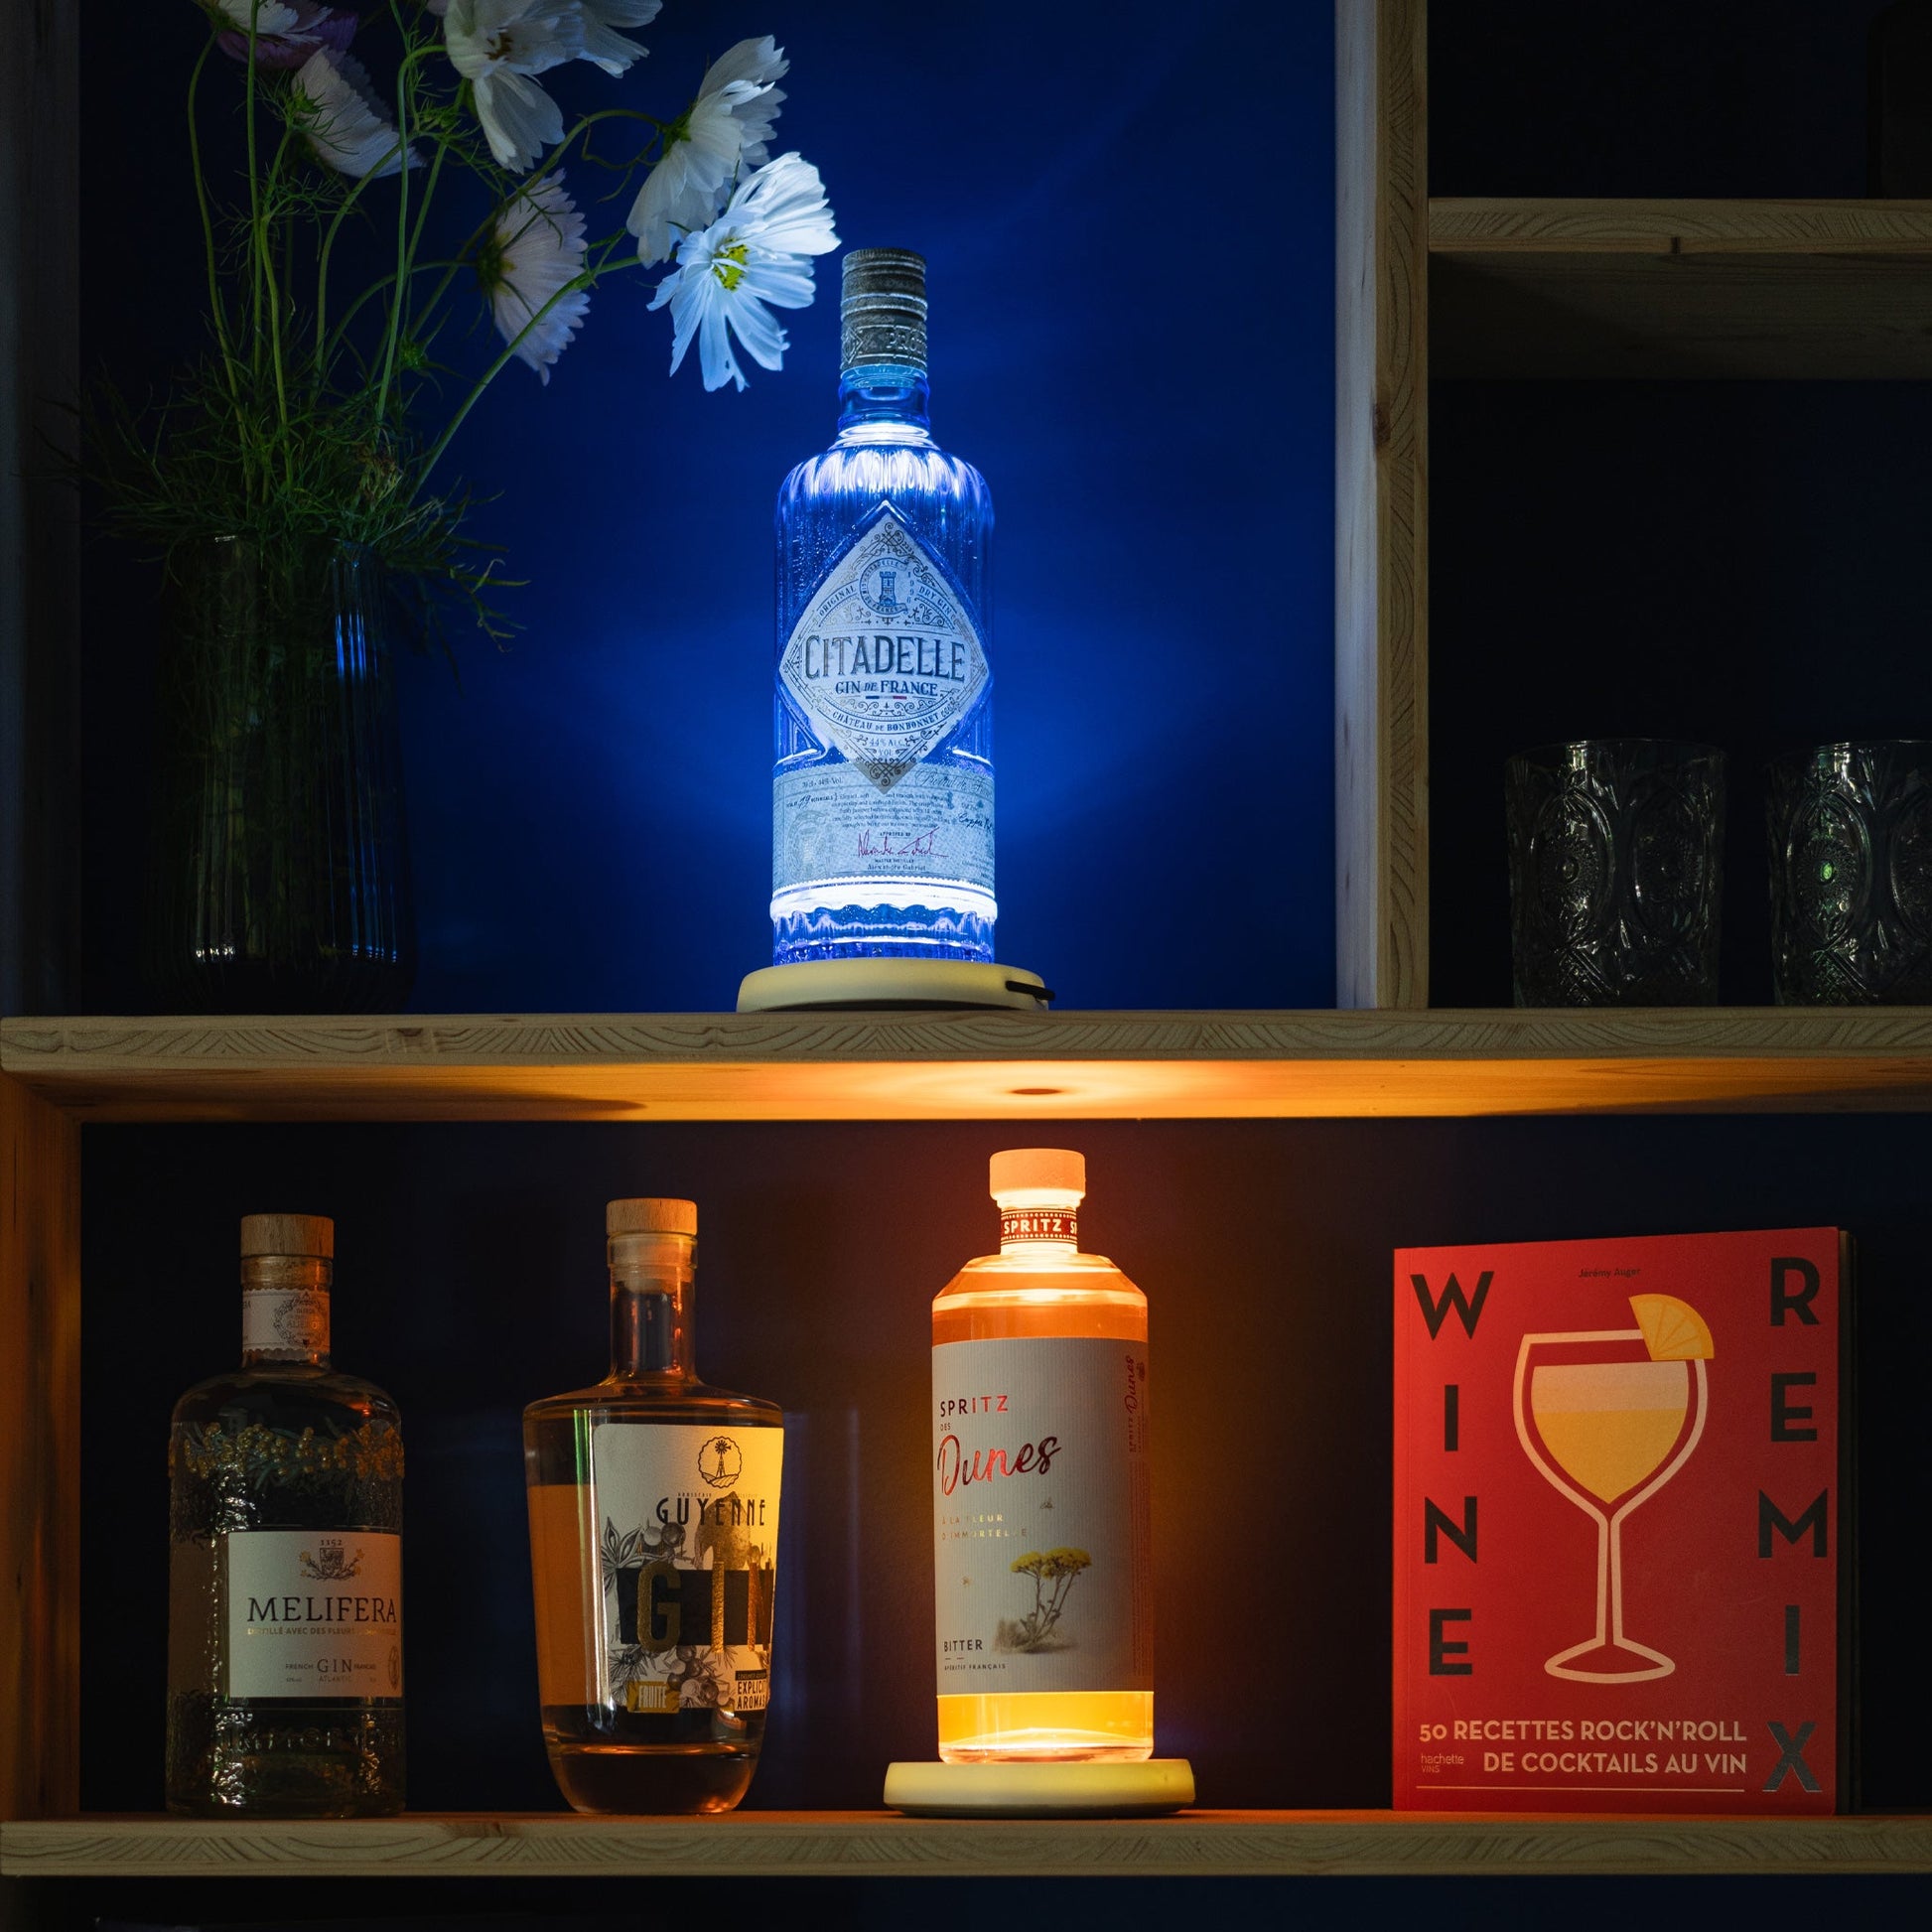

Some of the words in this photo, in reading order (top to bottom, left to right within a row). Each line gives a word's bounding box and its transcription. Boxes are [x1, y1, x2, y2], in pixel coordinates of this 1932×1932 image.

[819, 585, 856, 618] ORIGINAL
[918, 586, 936, 600] DRY
[936, 598, 952, 615] GIN
[805, 634, 965, 682] CITADELLE
[835, 680, 861, 694] GIN
[863, 682, 878, 692] DE
[880, 680, 938, 696] FRANCE
[832, 711, 874, 730] CHÂTEAU
[887, 713, 939, 732] BONBONNET
[1004, 1218, 1062, 1234] SPRITZ
[940, 1395, 1009, 1418] SPRITZ
[940, 1422, 951, 1432] DES
[937, 1434, 1061, 1496] Dunes
[1410, 1271, 1494, 1676] WINE
[656, 1497, 765, 1526] GUYENNE
[1757, 1256, 1829, 1794] REMIX
[247, 1596, 397, 1623] MELIFERA
[636, 1560, 771, 1656] GIN
[247, 1626, 283, 1636] DTILLÉ
[286, 1626, 308, 1636] AVEC
[310, 1626, 327, 1636] DES
[943, 1639, 983, 1652] BITTER
[317, 1658, 352, 1673] GIN
[1420, 1724, 1448, 1742] 50
[1453, 1720, 1575, 1740] RECETTES
[1421, 1752, 1464, 1765] hachette
[1421, 1764, 1441, 1774] VINS
[1483, 1751, 1514, 1772] DE
[1521, 1751, 1658, 1773] COCKTAILS
[1664, 1752, 1697, 1773] AU
[1705, 1752, 1747, 1774] VIN
